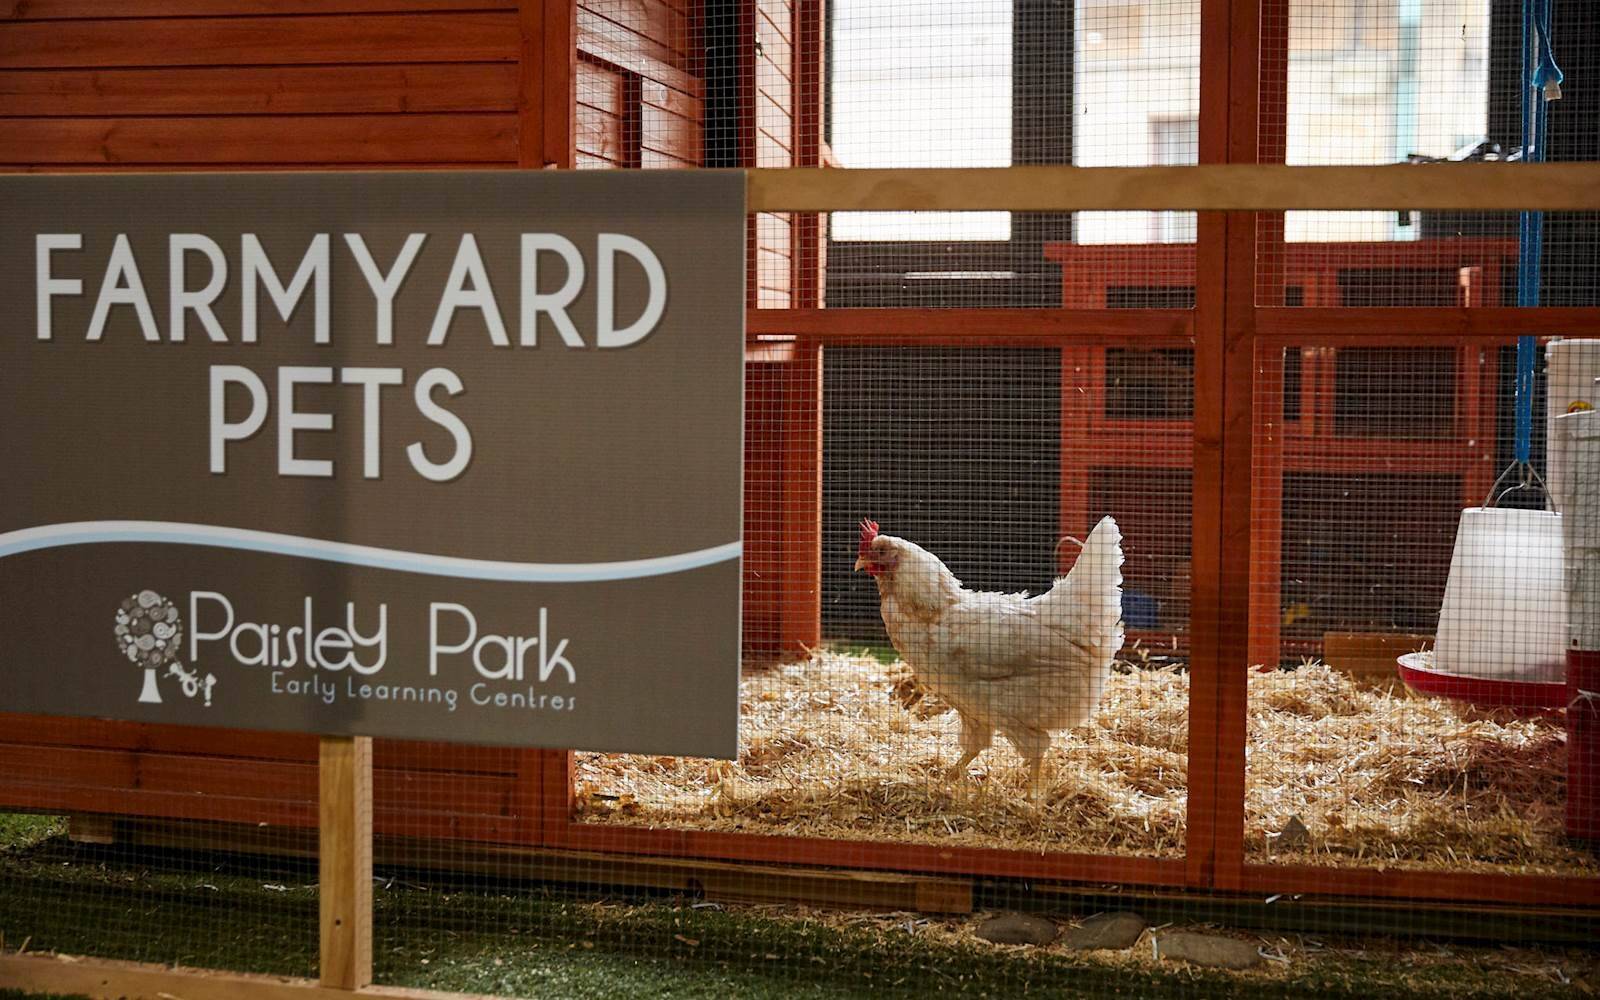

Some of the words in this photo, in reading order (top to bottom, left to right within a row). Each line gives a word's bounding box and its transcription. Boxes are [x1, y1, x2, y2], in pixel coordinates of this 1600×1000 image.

[36, 233, 667, 348] FARMYARD
[209, 365, 473, 481] PETS
[190, 590, 388, 675] Paisley
[429, 602, 577, 684] Park
[271, 671, 336, 704] Early
[347, 676, 458, 711] Learning
[470, 682, 576, 710] Centres
